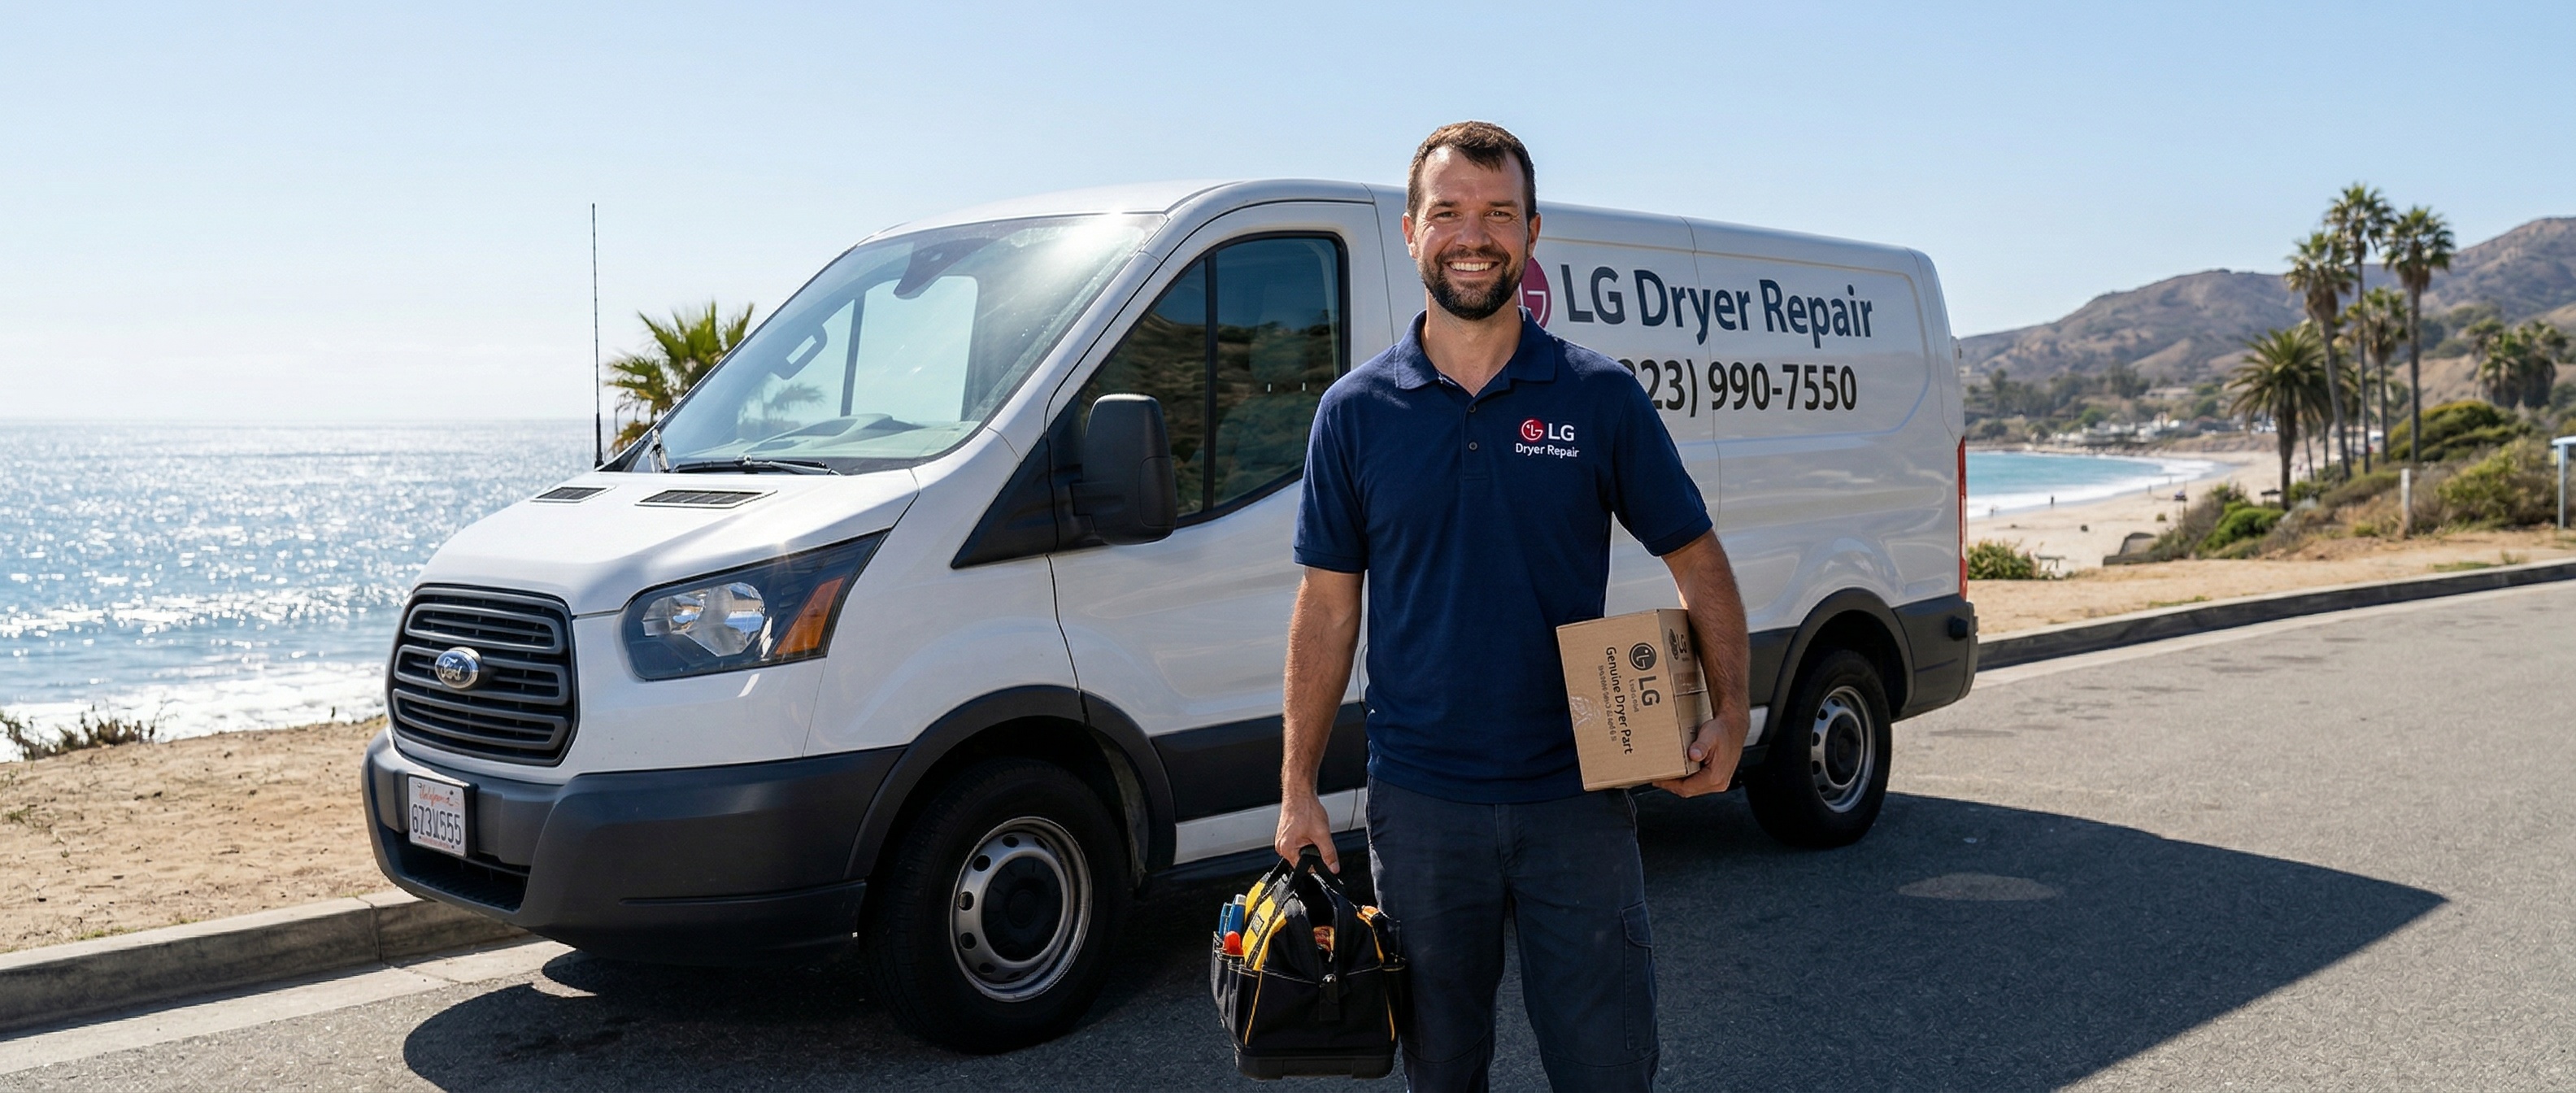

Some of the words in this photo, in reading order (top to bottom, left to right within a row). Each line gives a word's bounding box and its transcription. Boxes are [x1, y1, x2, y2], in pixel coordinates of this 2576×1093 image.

[1560, 264, 1625, 324] LG
[1634, 269, 1751, 346] Dryer
[1759, 279, 1873, 349] Repair
[1617, 359, 1698, 418] 23)
[1708, 362, 1857, 412] 990-7550
[1548, 423, 1574, 442] LG
[1516, 442, 1545, 456] Dryer
[1547, 444, 1580, 459] Repair
[441, 656, 463, 681] Ford
[1606, 647, 1621, 694] Genuine
[1638, 676, 1660, 707] LG
[1614, 695, 1628, 728] Dryer
[1620, 729, 1633, 755] Part
